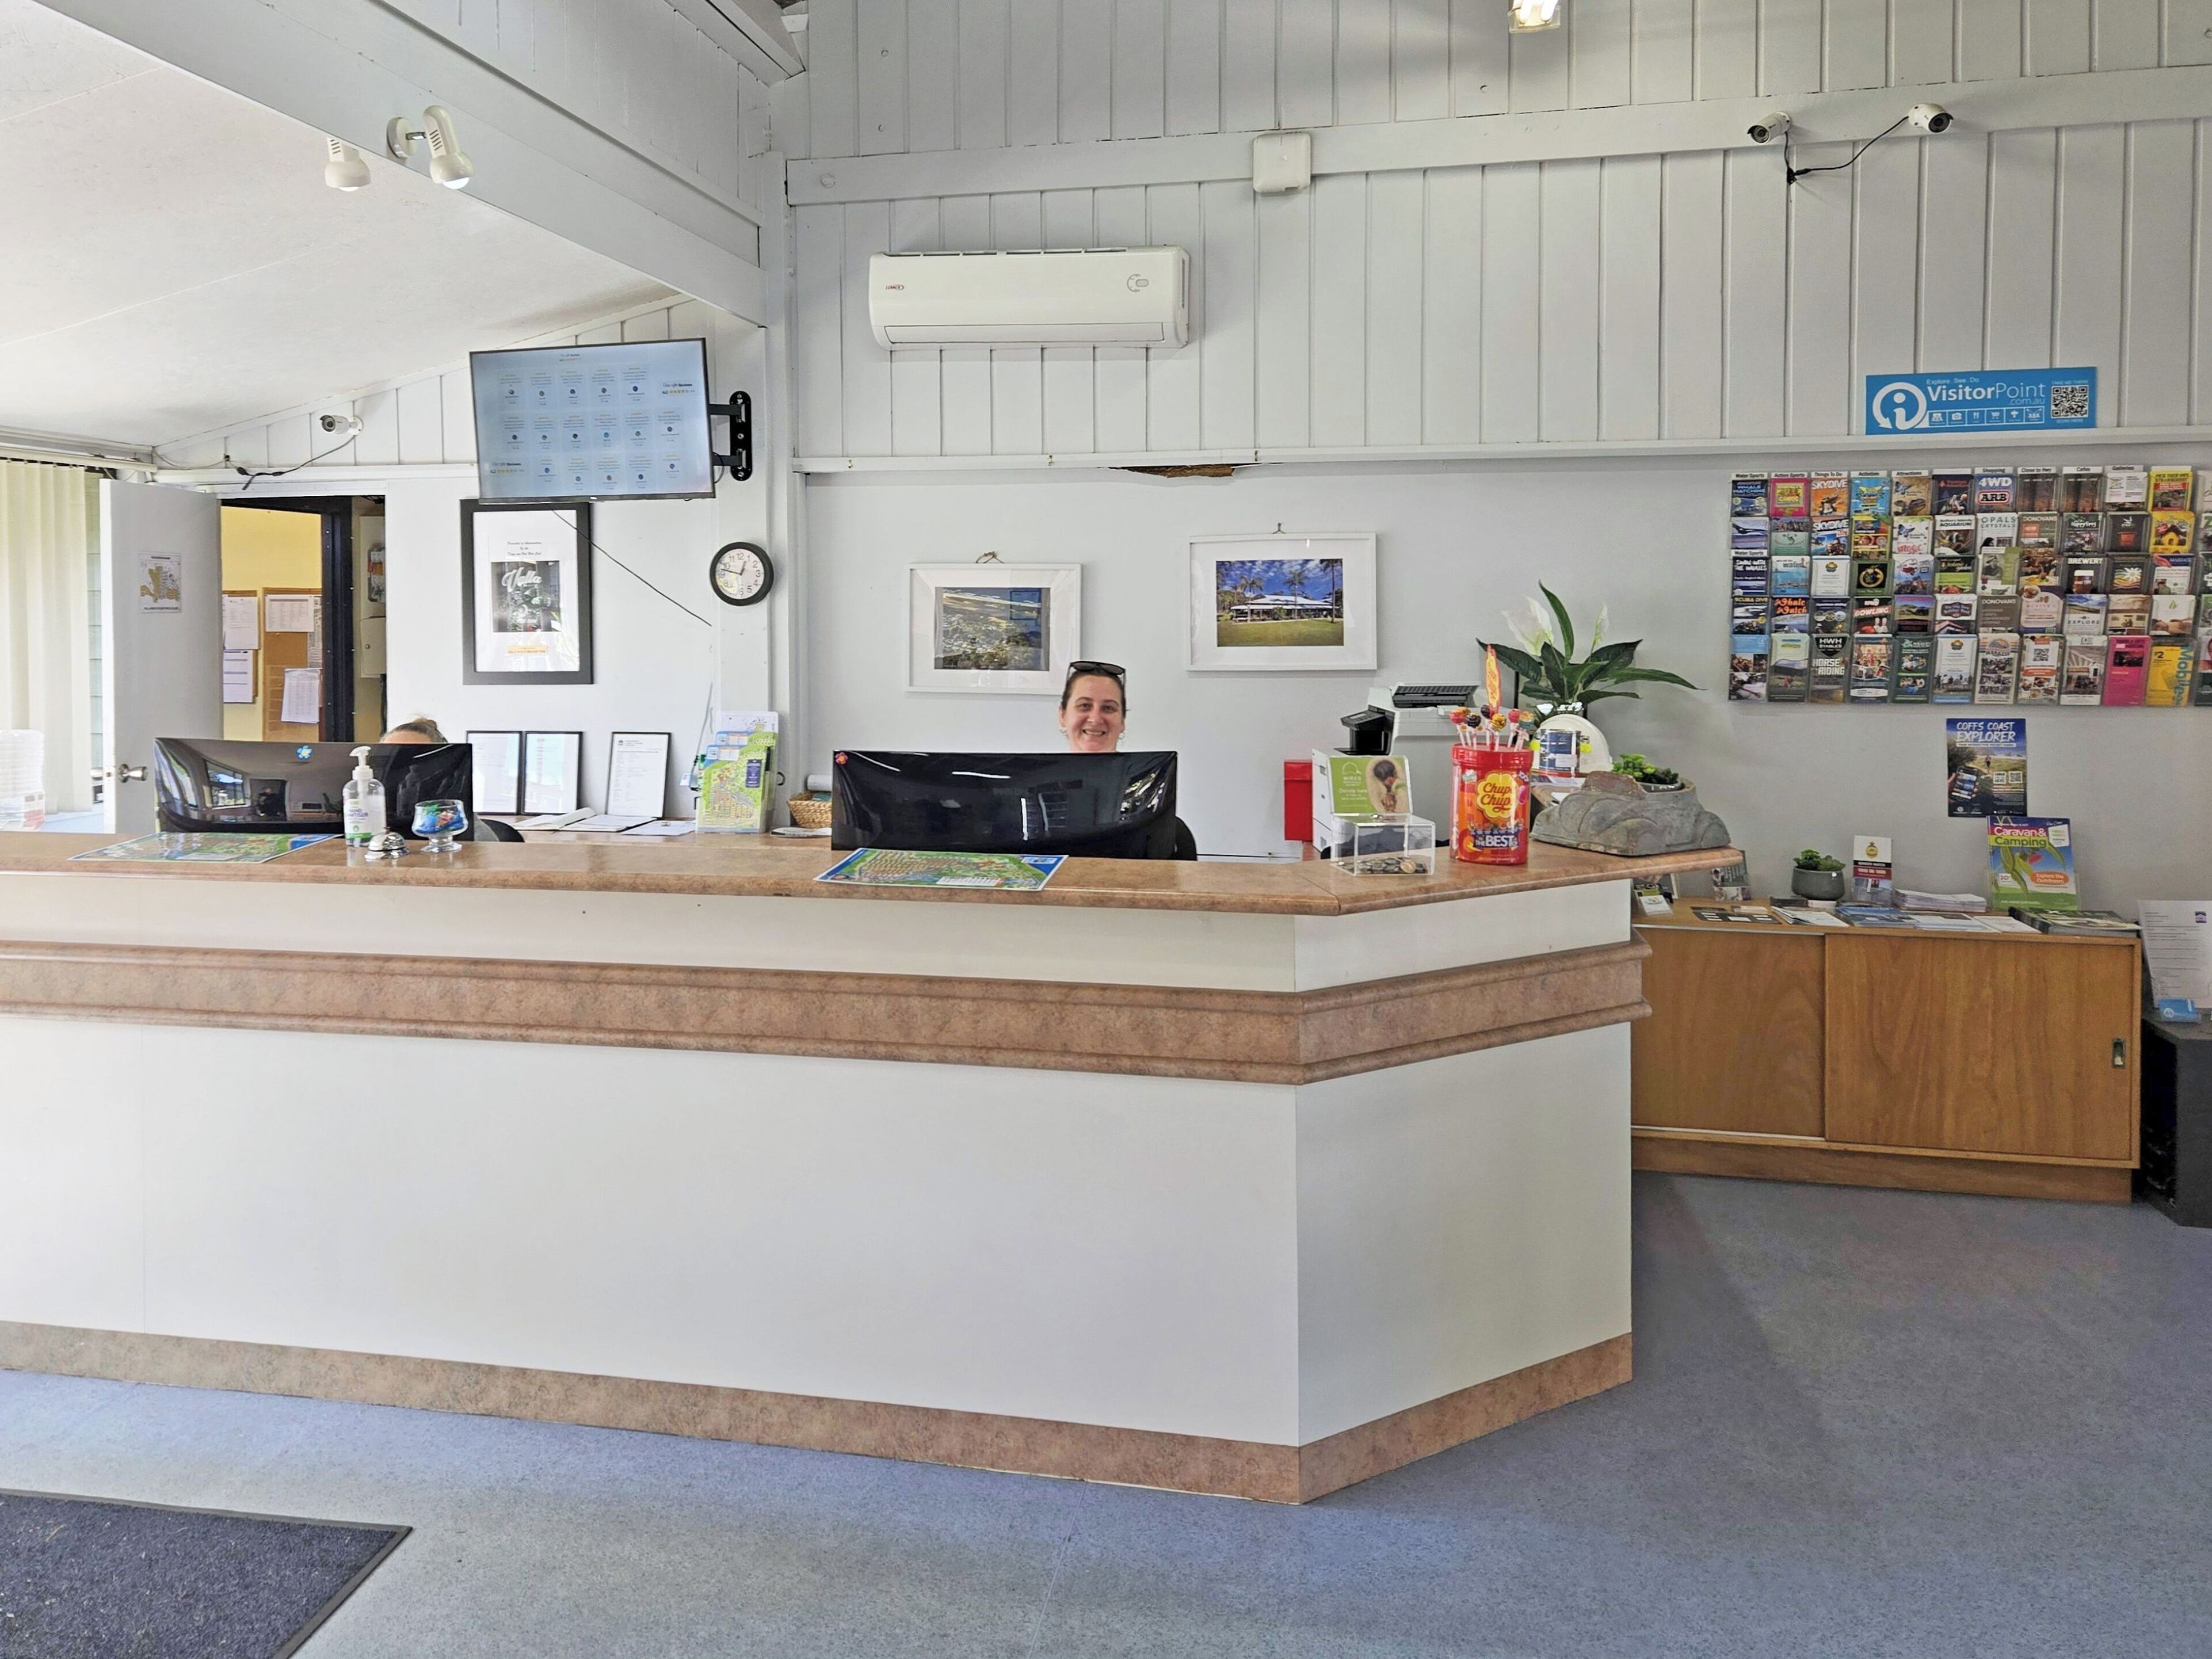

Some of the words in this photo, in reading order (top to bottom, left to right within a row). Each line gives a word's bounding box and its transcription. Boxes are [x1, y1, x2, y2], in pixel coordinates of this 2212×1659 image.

[1927, 382, 2046, 402] VisitorPoint
[1812, 479, 1848, 490] SKYDIVE
[1979, 477, 2013, 487] 4WD
[1980, 493, 2007, 502] ARB
[1813, 519, 1850, 532] SKYDIVE
[502, 567, 543, 593] Valla
[1854, 606, 1890, 617] BOWLING
[1813, 658, 1840, 667] HORSE
[1818, 666, 1846, 675] RIDING
[1956, 722, 1984, 731] COFFS
[1987, 721, 2016, 731] COAST
[1956, 730, 2017, 743] EXPLORER
[1483, 782, 1514, 796] Chup
[1480, 793, 1514, 808] Chup
[1994, 827, 2038, 836] Caravan
[2038, 827, 2047, 836] &
[1486, 835, 1514, 847] BEST
[1994, 836, 2047, 847] Camping
